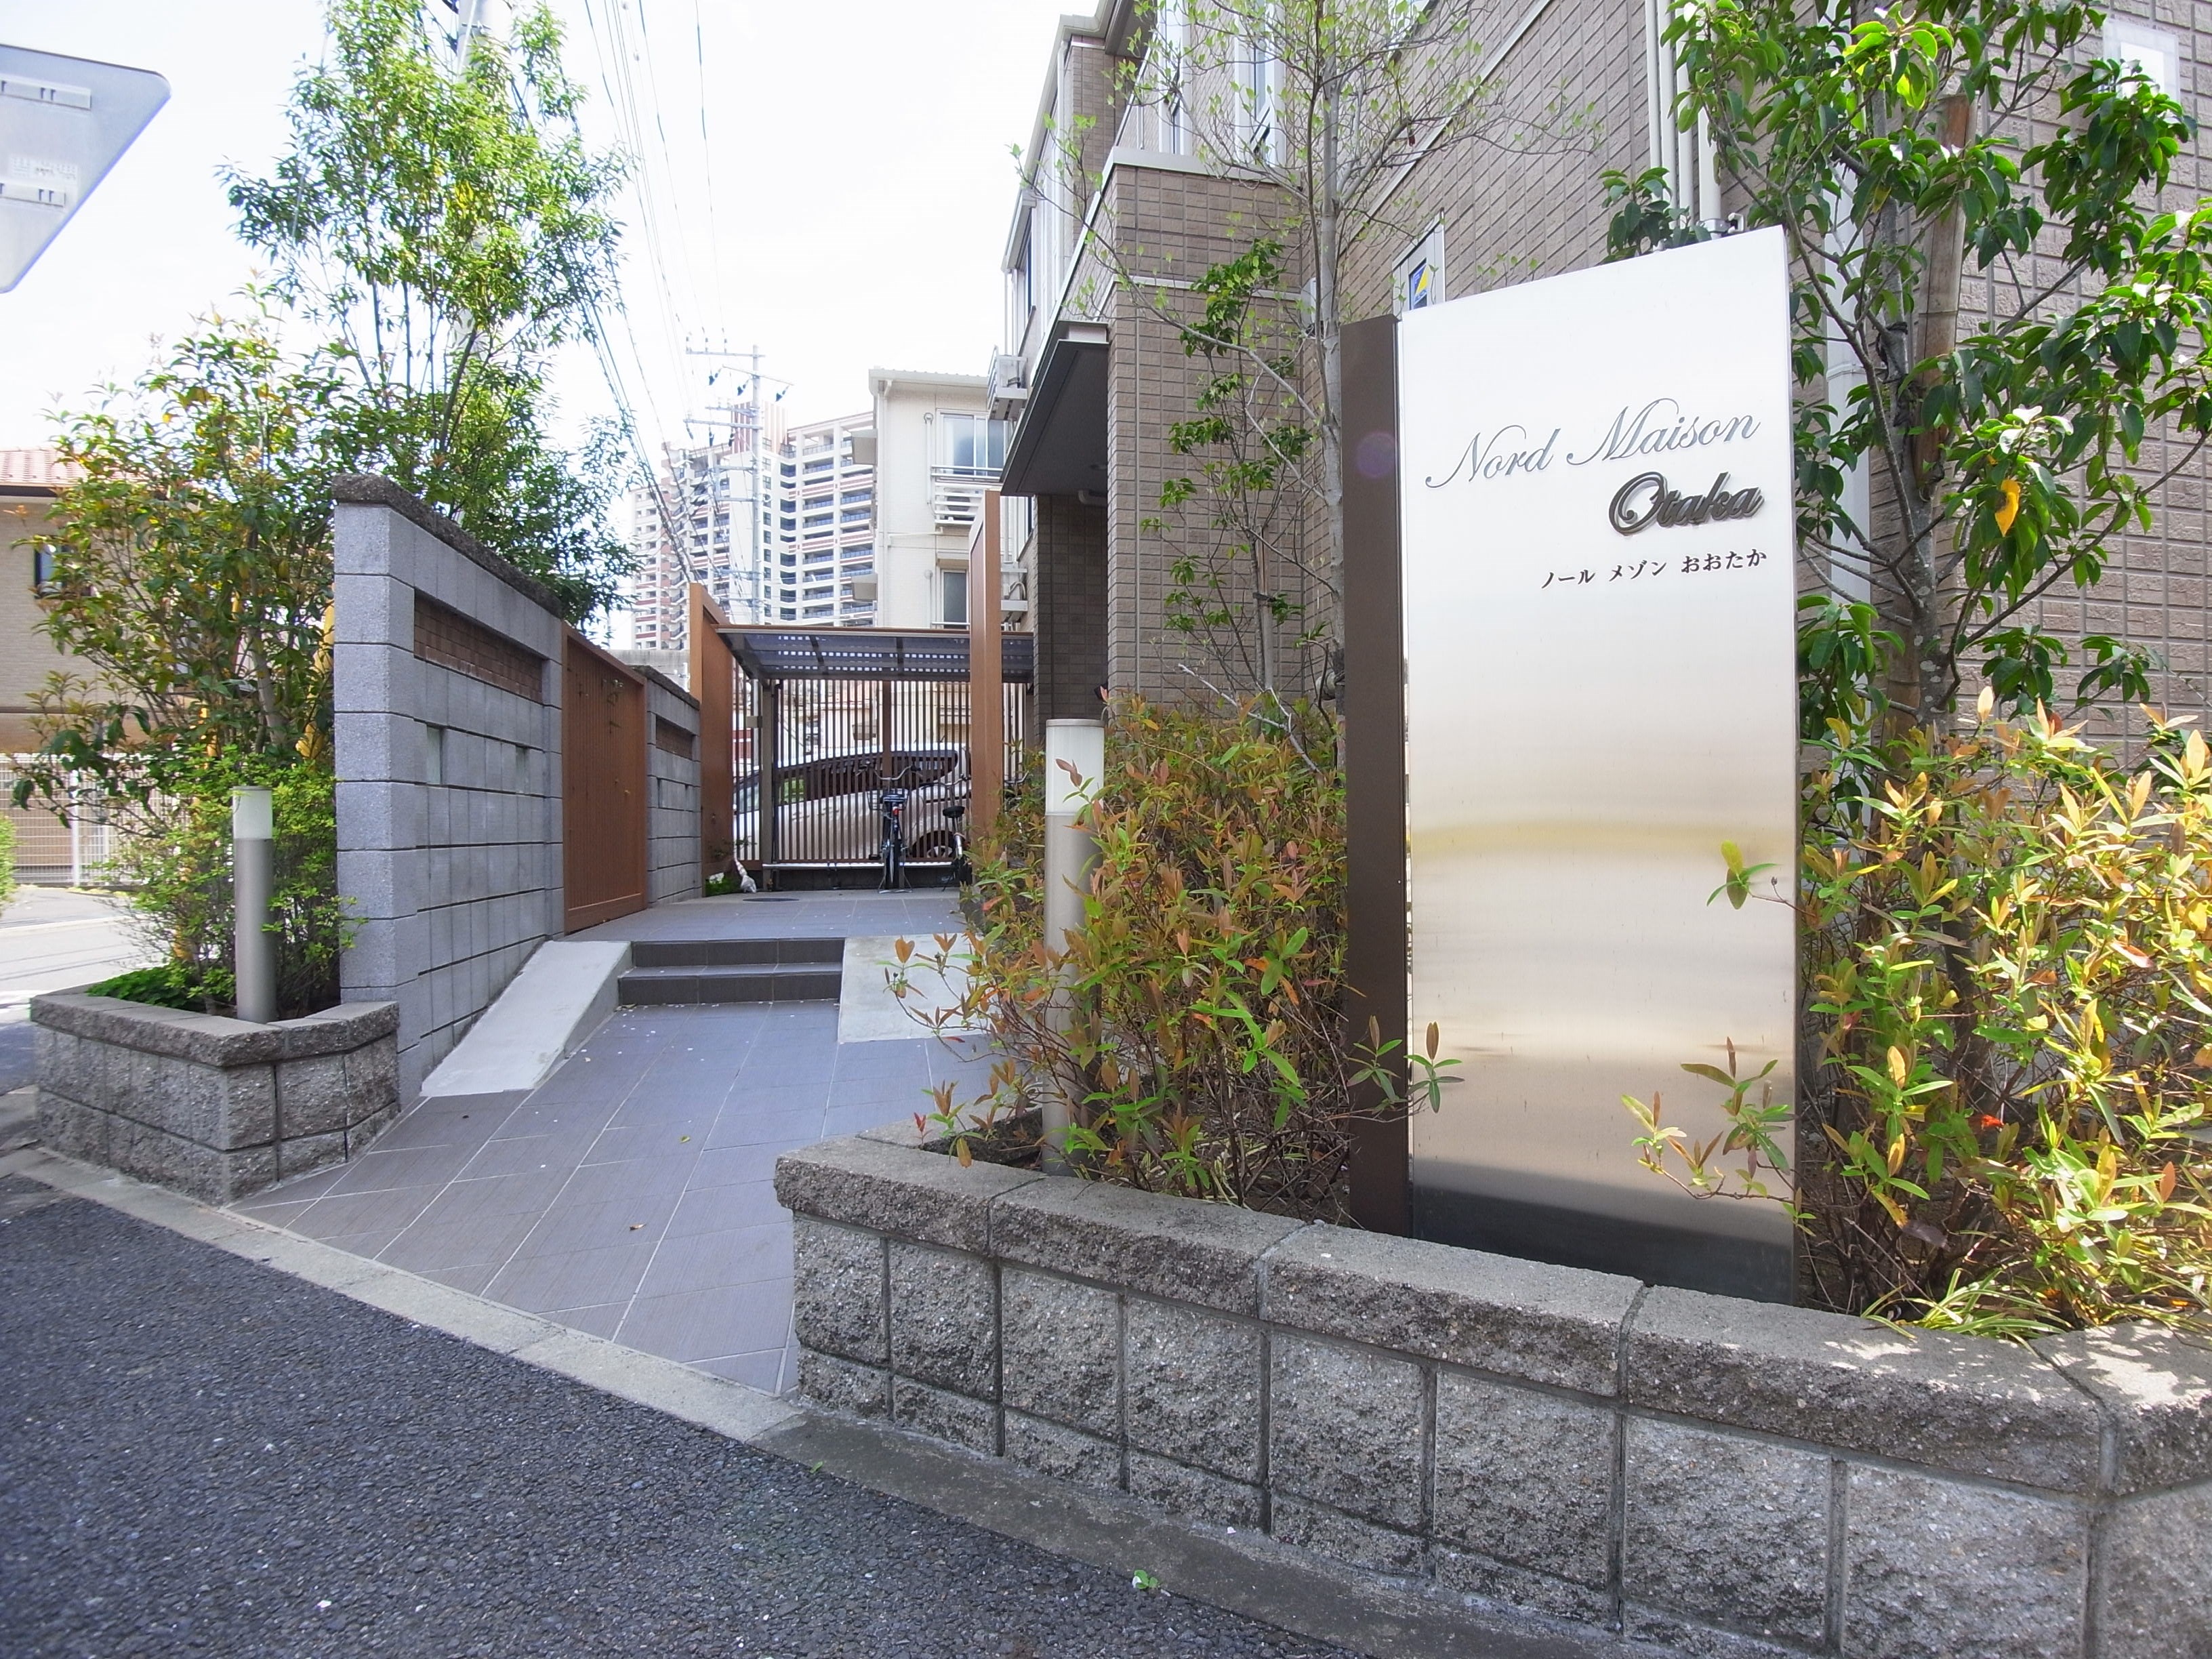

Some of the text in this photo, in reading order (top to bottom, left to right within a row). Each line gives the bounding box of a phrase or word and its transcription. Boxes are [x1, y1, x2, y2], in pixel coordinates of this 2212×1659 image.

[1425, 398, 1761, 488] Nord Maison
[1609, 470, 1765, 536] Otaka
[1541, 548, 1767, 589] ノール メゾン おおたか
